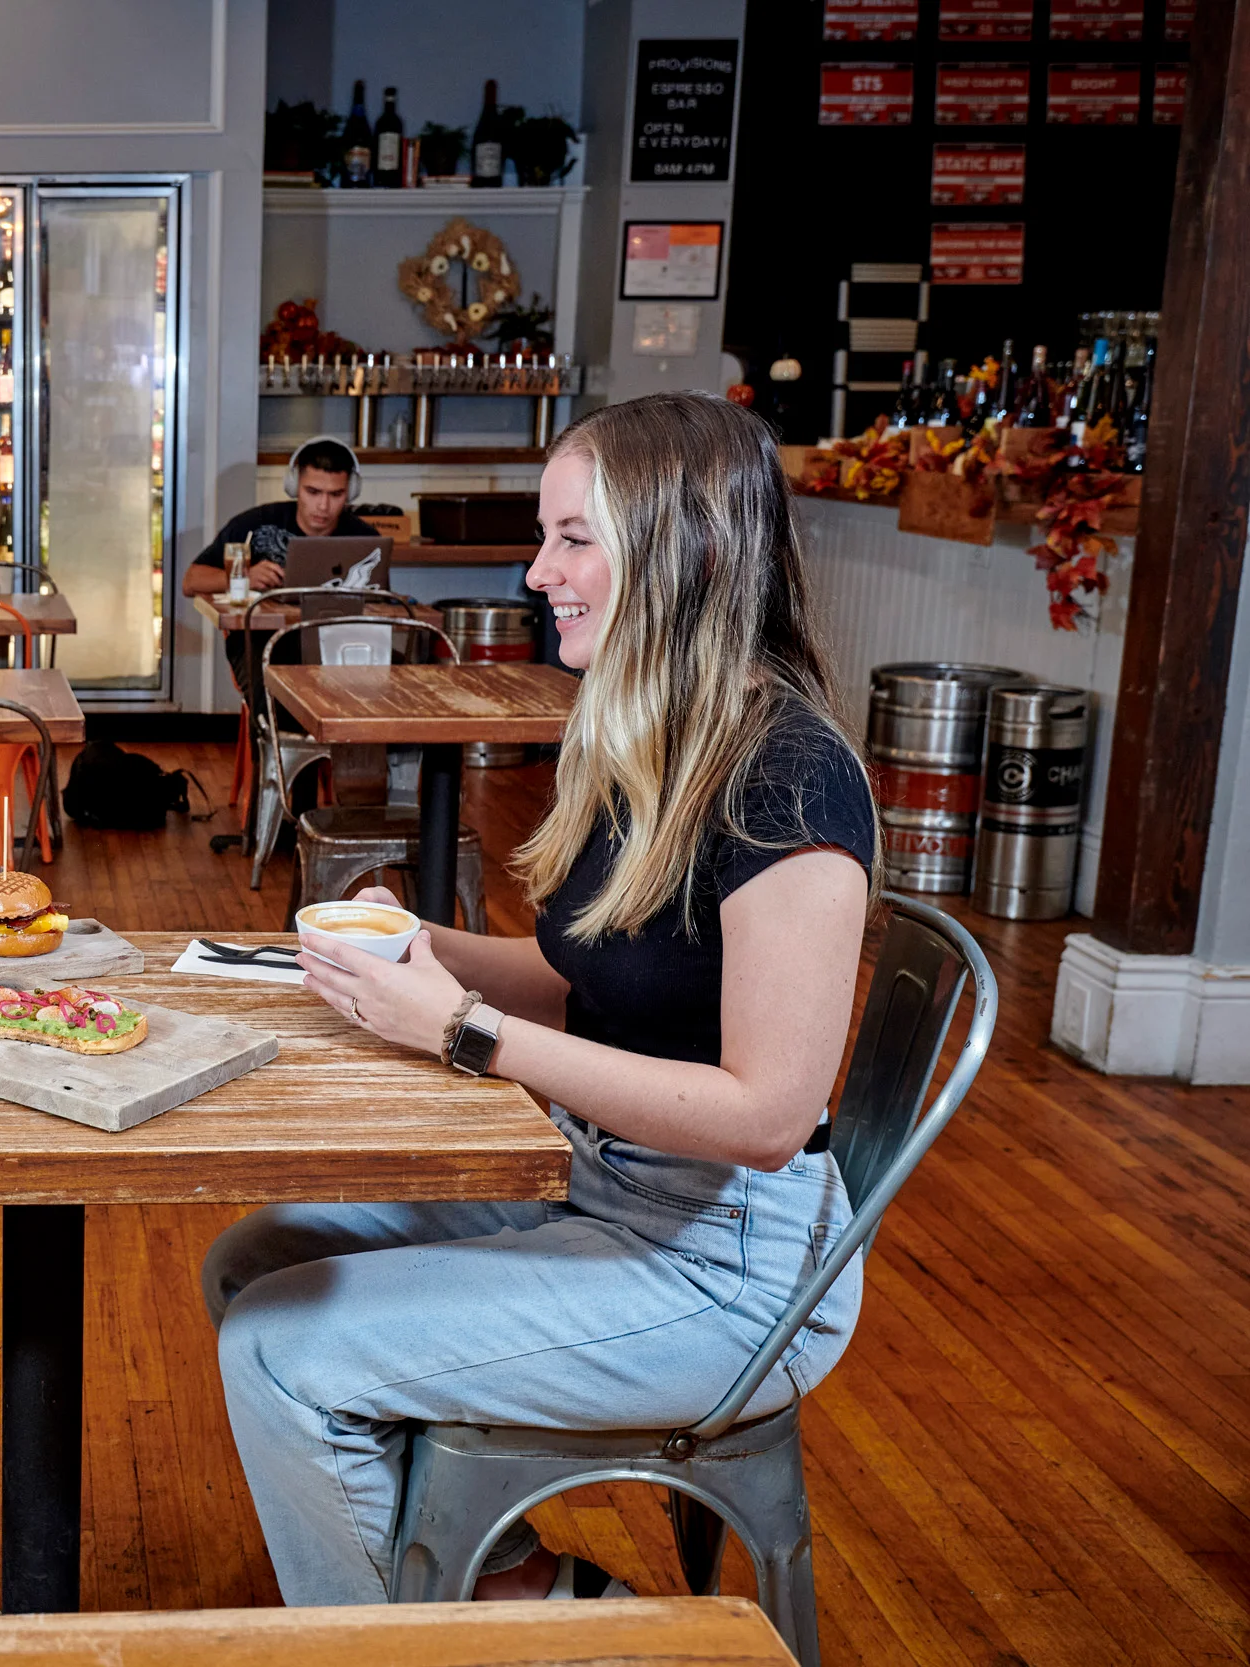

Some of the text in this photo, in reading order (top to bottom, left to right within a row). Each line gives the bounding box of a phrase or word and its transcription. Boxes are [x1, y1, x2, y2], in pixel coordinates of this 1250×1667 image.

[651, 81, 725, 95] ESPRESSO
[667, 97, 698, 110] BAR
[643, 122, 685, 135] OPEN
